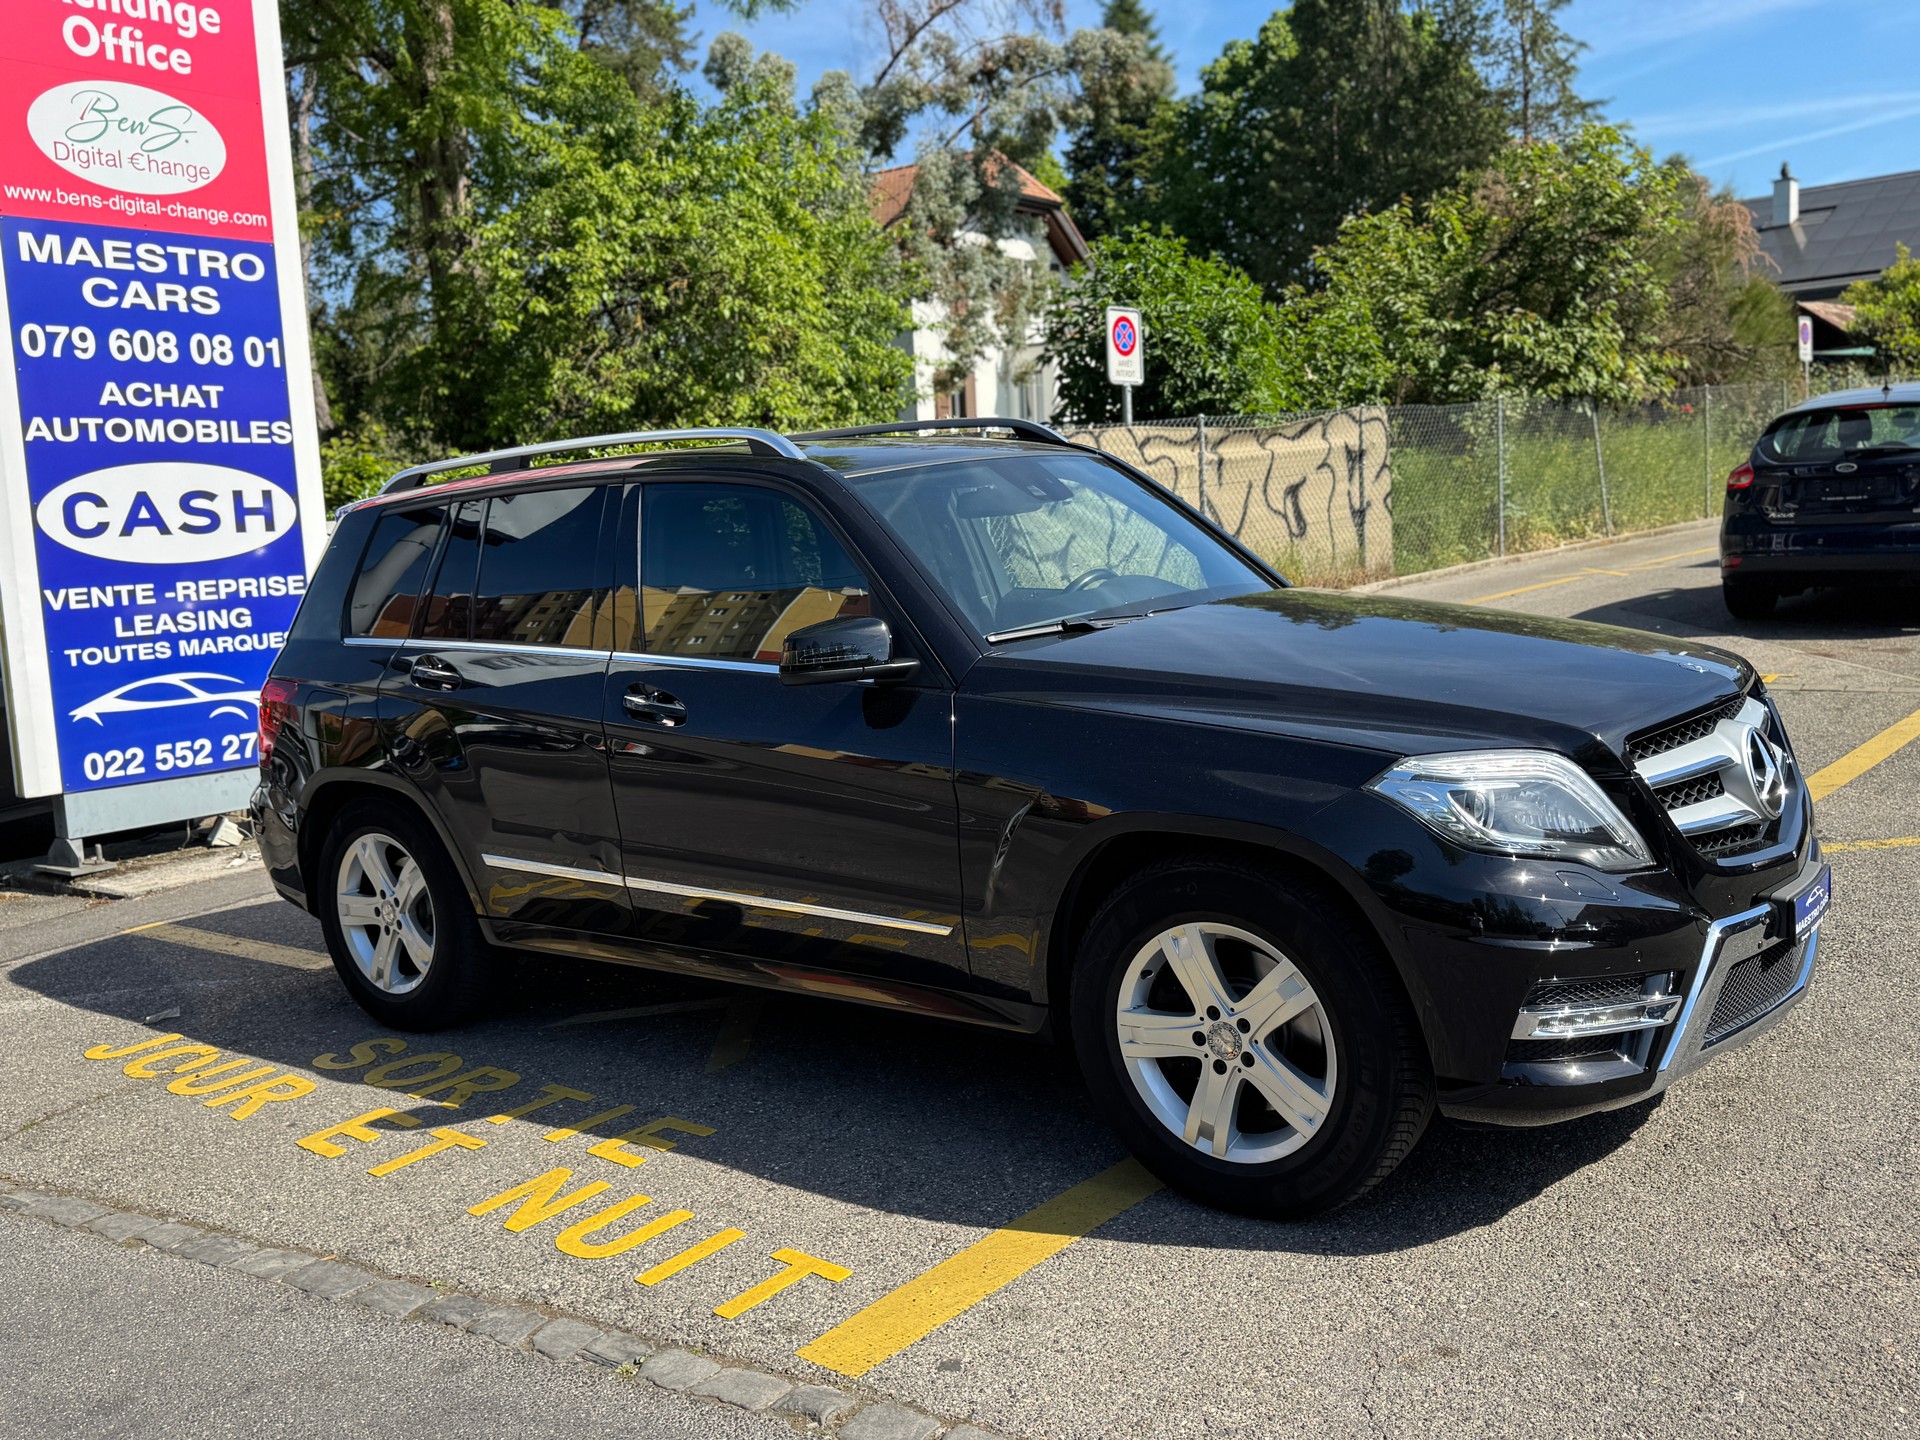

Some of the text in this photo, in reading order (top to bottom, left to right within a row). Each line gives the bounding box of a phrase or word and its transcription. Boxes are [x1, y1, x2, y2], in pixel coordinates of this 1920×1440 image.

[62, 14, 192, 75] Office
[53, 141, 123, 170] Digital
[4, 185, 268, 227] www.bens-digital-change.com
[18, 231, 265, 282] MAESTRO
[82, 277, 221, 315] CARS
[20, 323, 281, 368] 079 608 08 01
[99, 382, 224, 408] ACHAT
[25, 417, 293, 444] AUTOMOBILES
[62, 489, 276, 540] CASH
[44, 583, 156, 611] VENTE
[114, 608, 252, 638] LEASING
[64, 641, 172, 667] TOUTES
[83, 732, 258, 781] 022 552 27
[312, 1037, 716, 1168] SORTIE
[83, 1032, 854, 1320] JOUR ET NUIT
